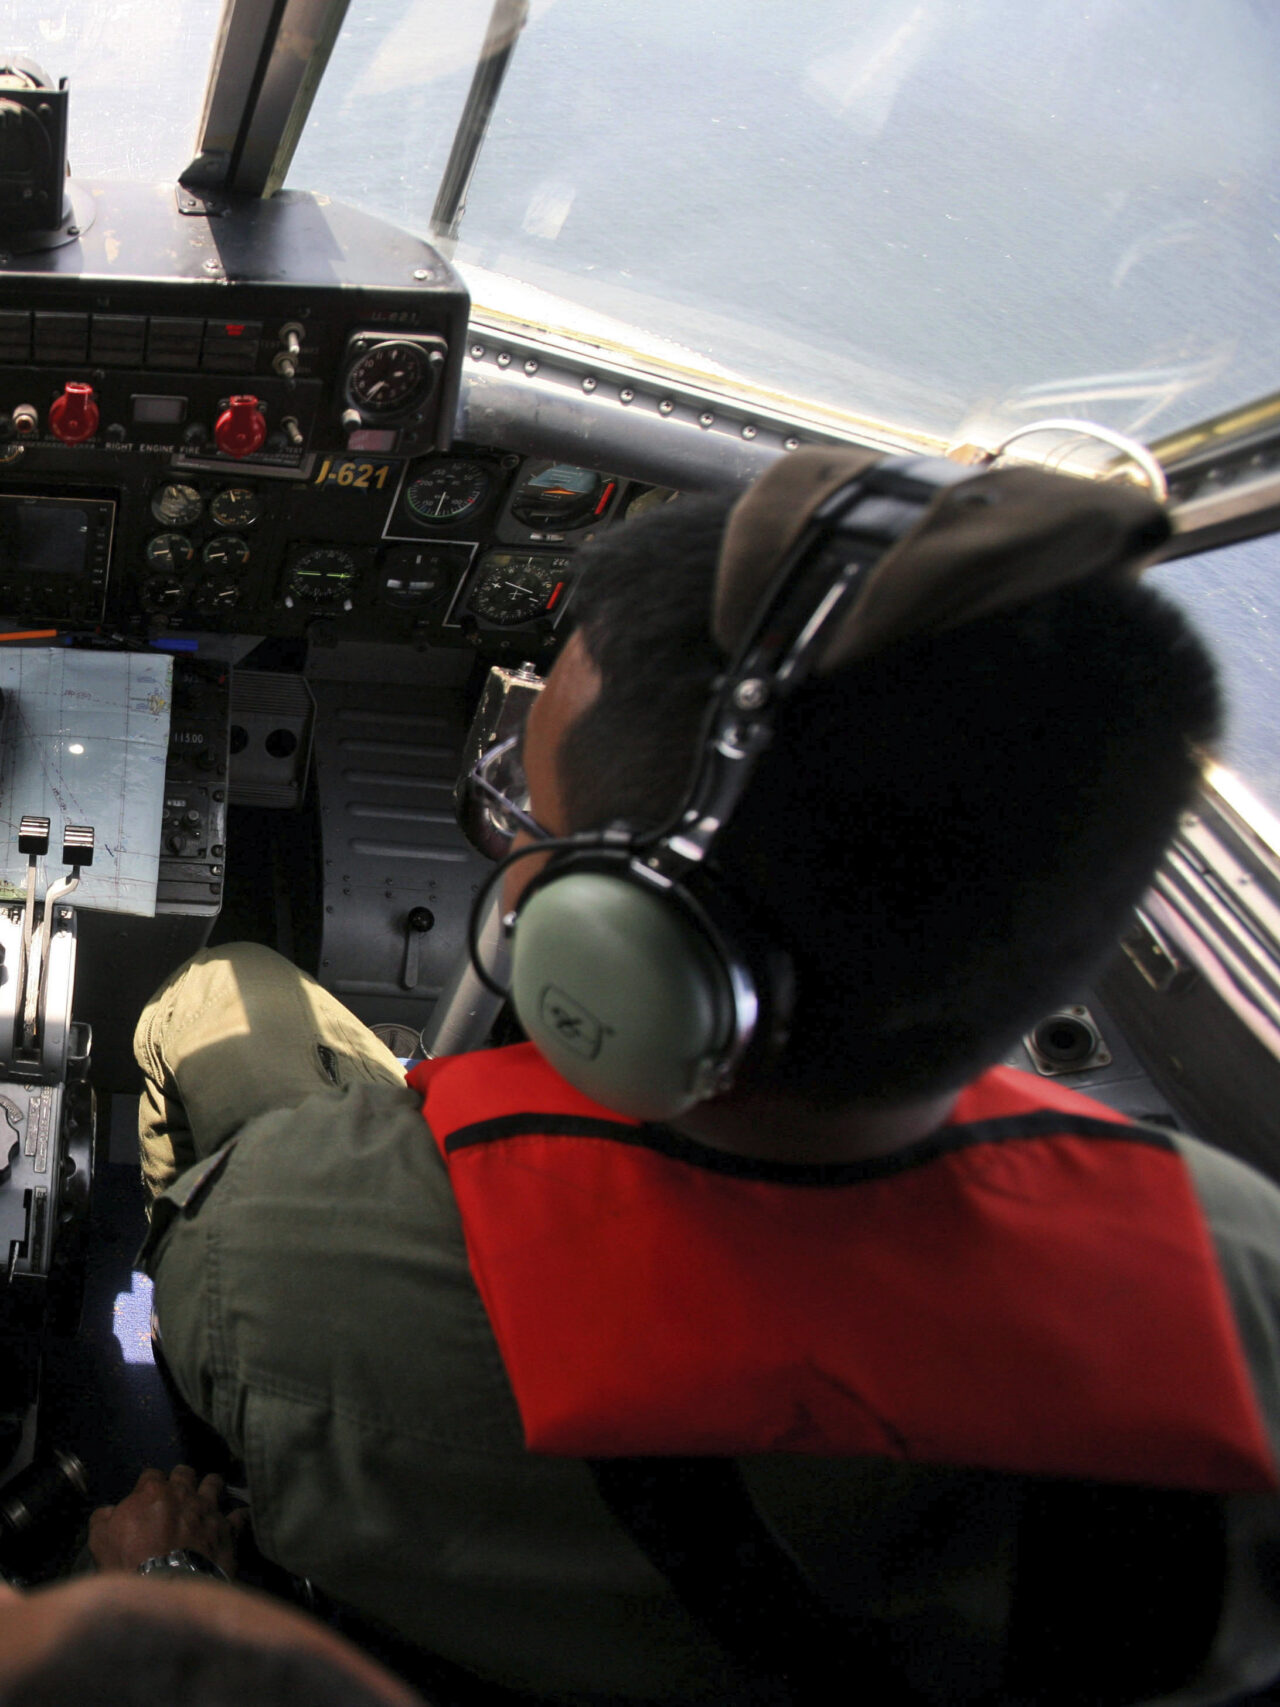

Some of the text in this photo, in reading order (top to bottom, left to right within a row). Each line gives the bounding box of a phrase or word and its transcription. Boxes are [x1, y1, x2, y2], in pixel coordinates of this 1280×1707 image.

[105, 441, 201, 455] RIGHT ENGINE FIRE
[314, 458, 391, 490] J-621
